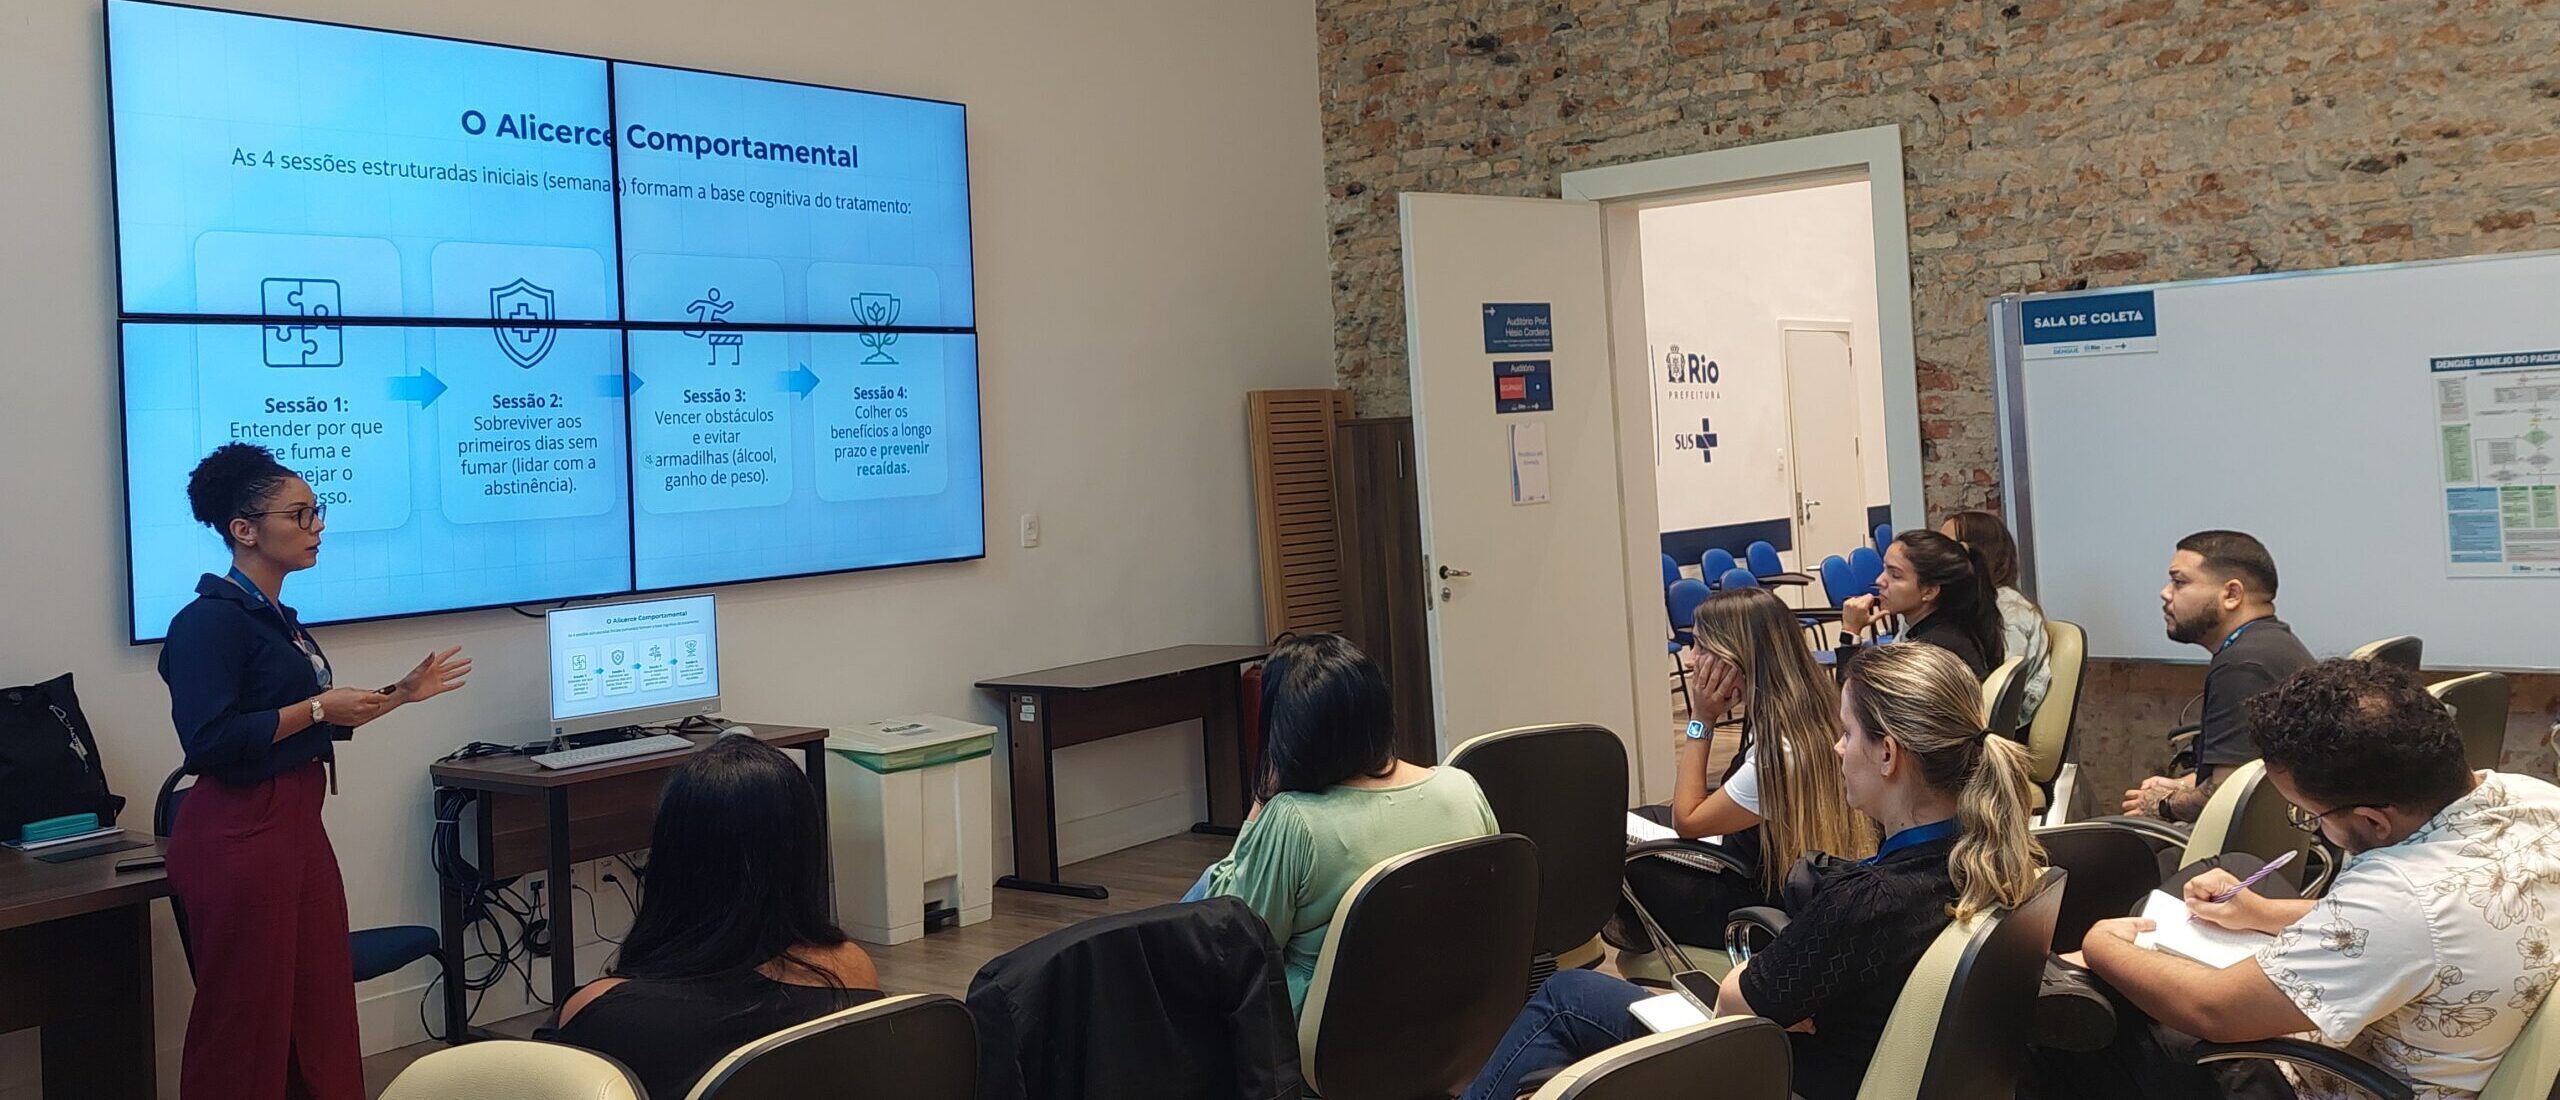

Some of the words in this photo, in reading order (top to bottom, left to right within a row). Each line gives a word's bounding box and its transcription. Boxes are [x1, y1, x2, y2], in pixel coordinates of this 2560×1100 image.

[461, 109, 487, 136] O
[627, 123, 859, 169] Comportamental
[232, 147, 257, 168] As
[262, 150, 275, 168] 4
[281, 150, 357, 176] sessões
[362, 159, 478, 184] estruturadas
[482, 166, 539, 188] iniciais
[631, 176, 693, 200] formam
[698, 187, 707, 200] a
[711, 183, 745, 203] base
[749, 186, 811, 210] cognitiva
[815, 192, 833, 210] do
[836, 195, 912, 215] tratamento:
[1506, 316, 1533, 326] Auditório
[2034, 316, 2067, 329] SALA
[2070, 314, 2087, 326] DE
[2090, 310, 2144, 325] COLETA
[1524, 327, 1550, 337] Cordeiro
[1688, 353, 1719, 384] Rio
[2435, 359, 2475, 369] DENGUE:
[2476, 356, 2513, 366] MANEJO
[2515, 355, 2528, 365] DO
[492, 393, 545, 411] Sessão
[549, 393, 563, 409] 2:
[683, 388, 731, 404] Sessão
[735, 389, 747, 403] 3:
[854, 386, 894, 401] Sessão
[897, 387, 908, 400] 4:
[1669, 390, 1720, 400] PREFEITURA
[264, 396, 328, 414] Sessão
[333, 397, 349, 413] 1:
[855, 404, 891, 420] Colher
[895, 406, 908, 419] os
[474, 415, 553, 432] Sobreviver
[557, 416, 582, 430] aos
[655, 409, 703, 425] Vencer
[705, 407, 774, 424] obstáculos
[230, 420, 313, 438] Entender
[317, 423, 348, 441] por
[351, 420, 383, 444] que
[693, 434, 701, 445] e
[704, 429, 741, 444] evitar
[831, 424, 889, 440] benefícios
[892, 427, 899, 438] a
[901, 423, 932, 440] longo
[457, 435, 531, 458] primeiros
[535, 435, 569, 451] dias
[573, 437, 598, 450] sem
[1675, 433, 1694, 450] SUS
[290, 443, 337, 461] fuma
[341, 445, 352, 459] e
[656, 449, 729, 467] armadilhas
[732, 446, 777, 467] (álcool,
[834, 446, 867, 463] prazo
[870, 446, 877, 457] e
[880, 442, 930, 460] prevenir
[342, 468, 353, 482] o
[461, 458, 507, 476] fumar
[512, 455, 553, 477] (lidar
[557, 458, 585, 473] com
[588, 458, 597, 471] a
[857, 461, 911, 478] recaídas.
[484, 477, 577, 497] abstinência).
[665, 471, 707, 492] ganho
[711, 469, 728, 485] de
[731, 468, 769, 488] peso).
[638, 611, 688, 621] Comportamental
